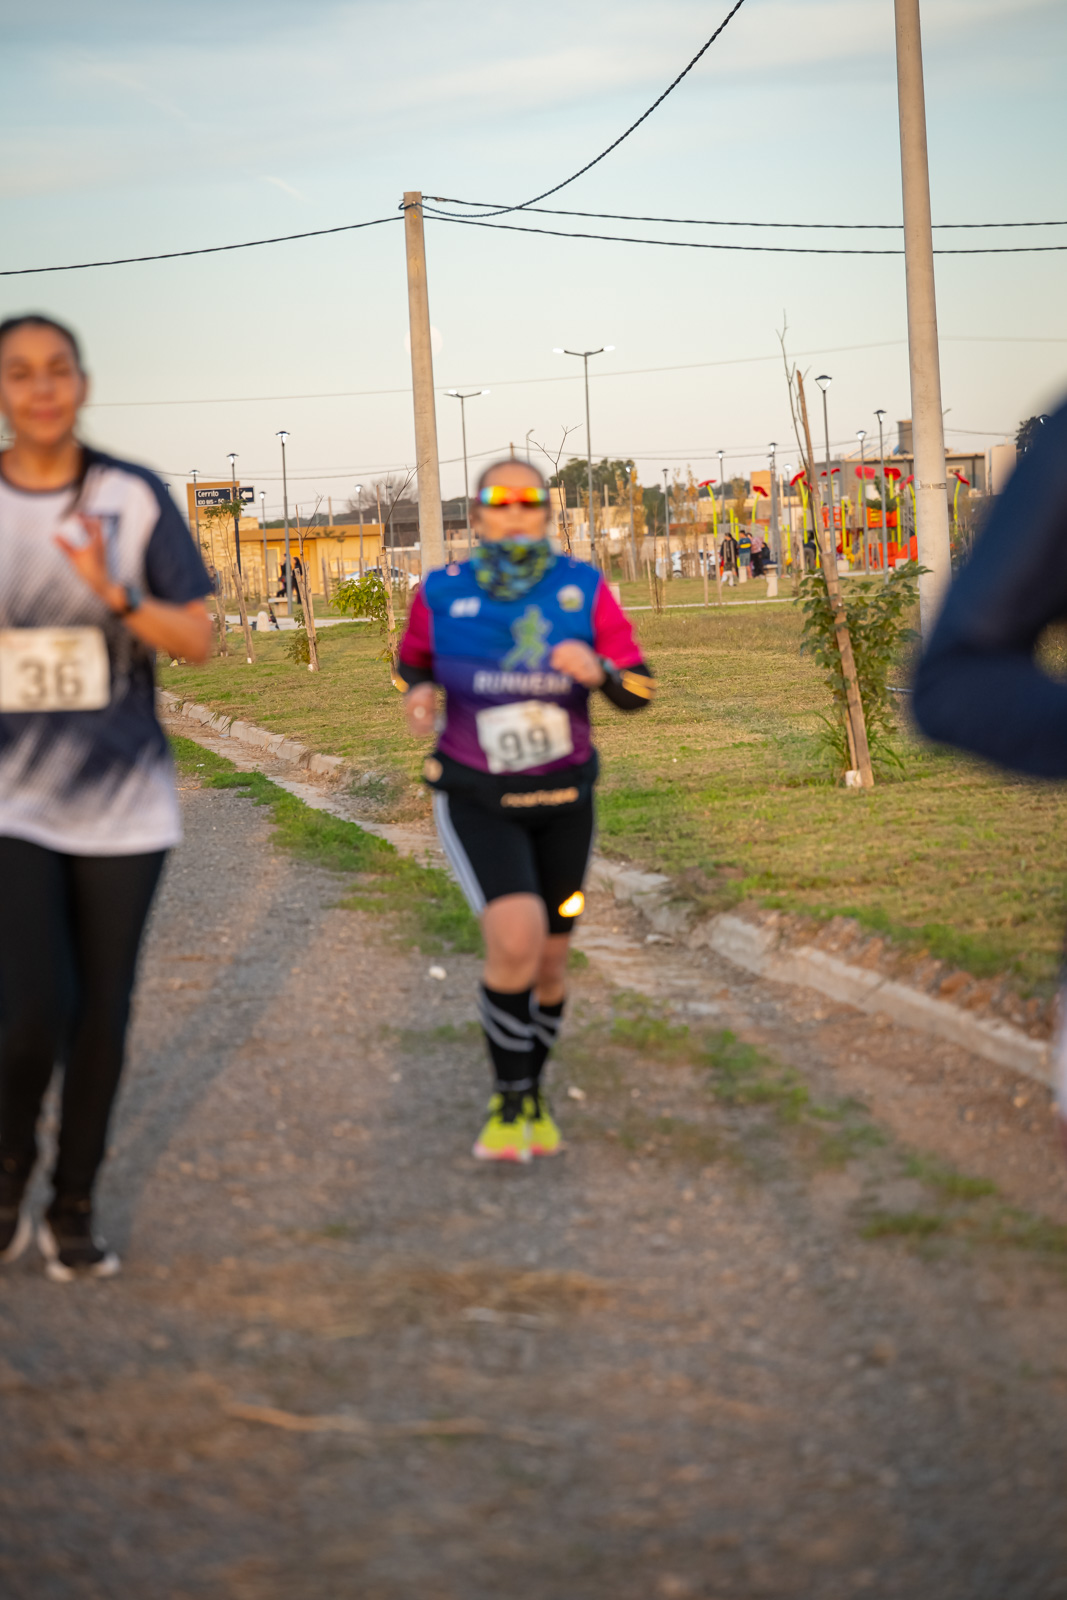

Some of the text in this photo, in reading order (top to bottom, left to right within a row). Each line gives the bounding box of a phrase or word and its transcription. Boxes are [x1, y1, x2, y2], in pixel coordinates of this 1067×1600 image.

[197, 490, 219, 498] Cerrito
[18, 659, 84, 708] 36
[499, 725, 551, 767] 99
